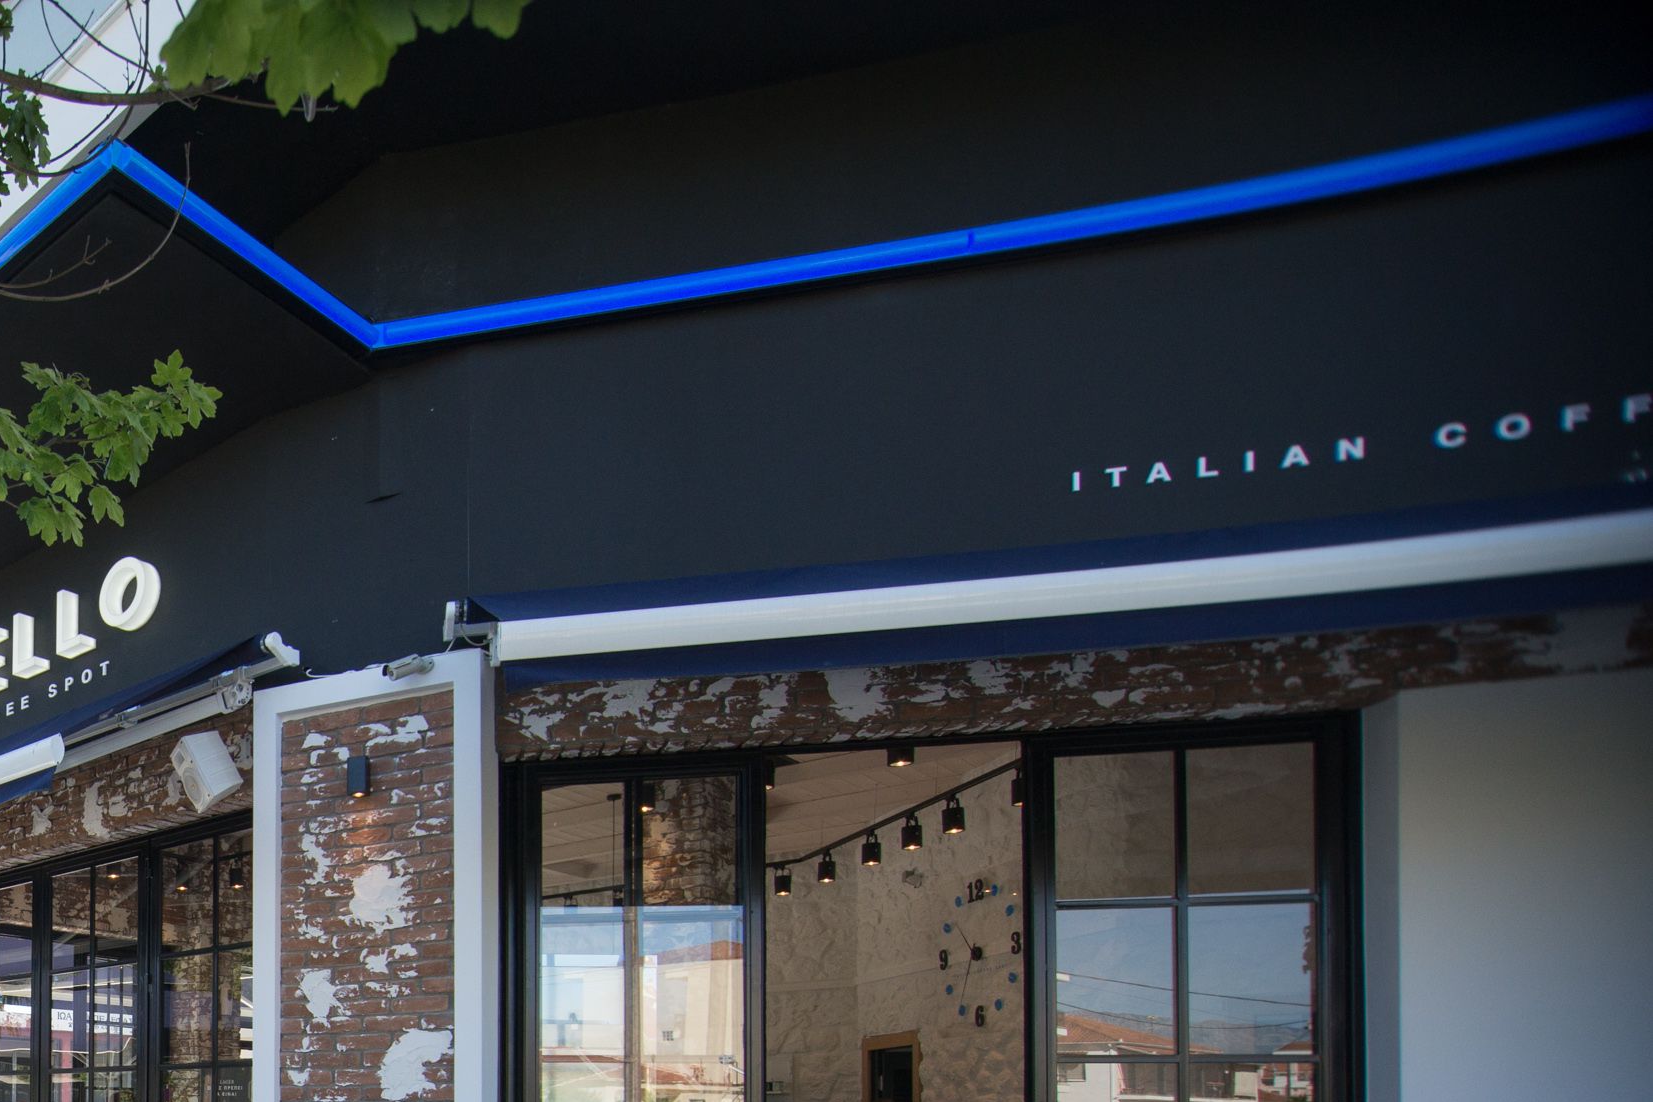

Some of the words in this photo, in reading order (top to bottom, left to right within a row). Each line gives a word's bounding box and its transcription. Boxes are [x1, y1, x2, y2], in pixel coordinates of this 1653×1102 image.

[1071, 436, 1366, 491] ITALIAN
[48, 660, 111, 698] SPOT
[966, 878, 985, 904] 12
[1010, 931, 1022, 954] 3
[939, 949, 949, 971] 9
[975, 1005, 985, 1027] 6
